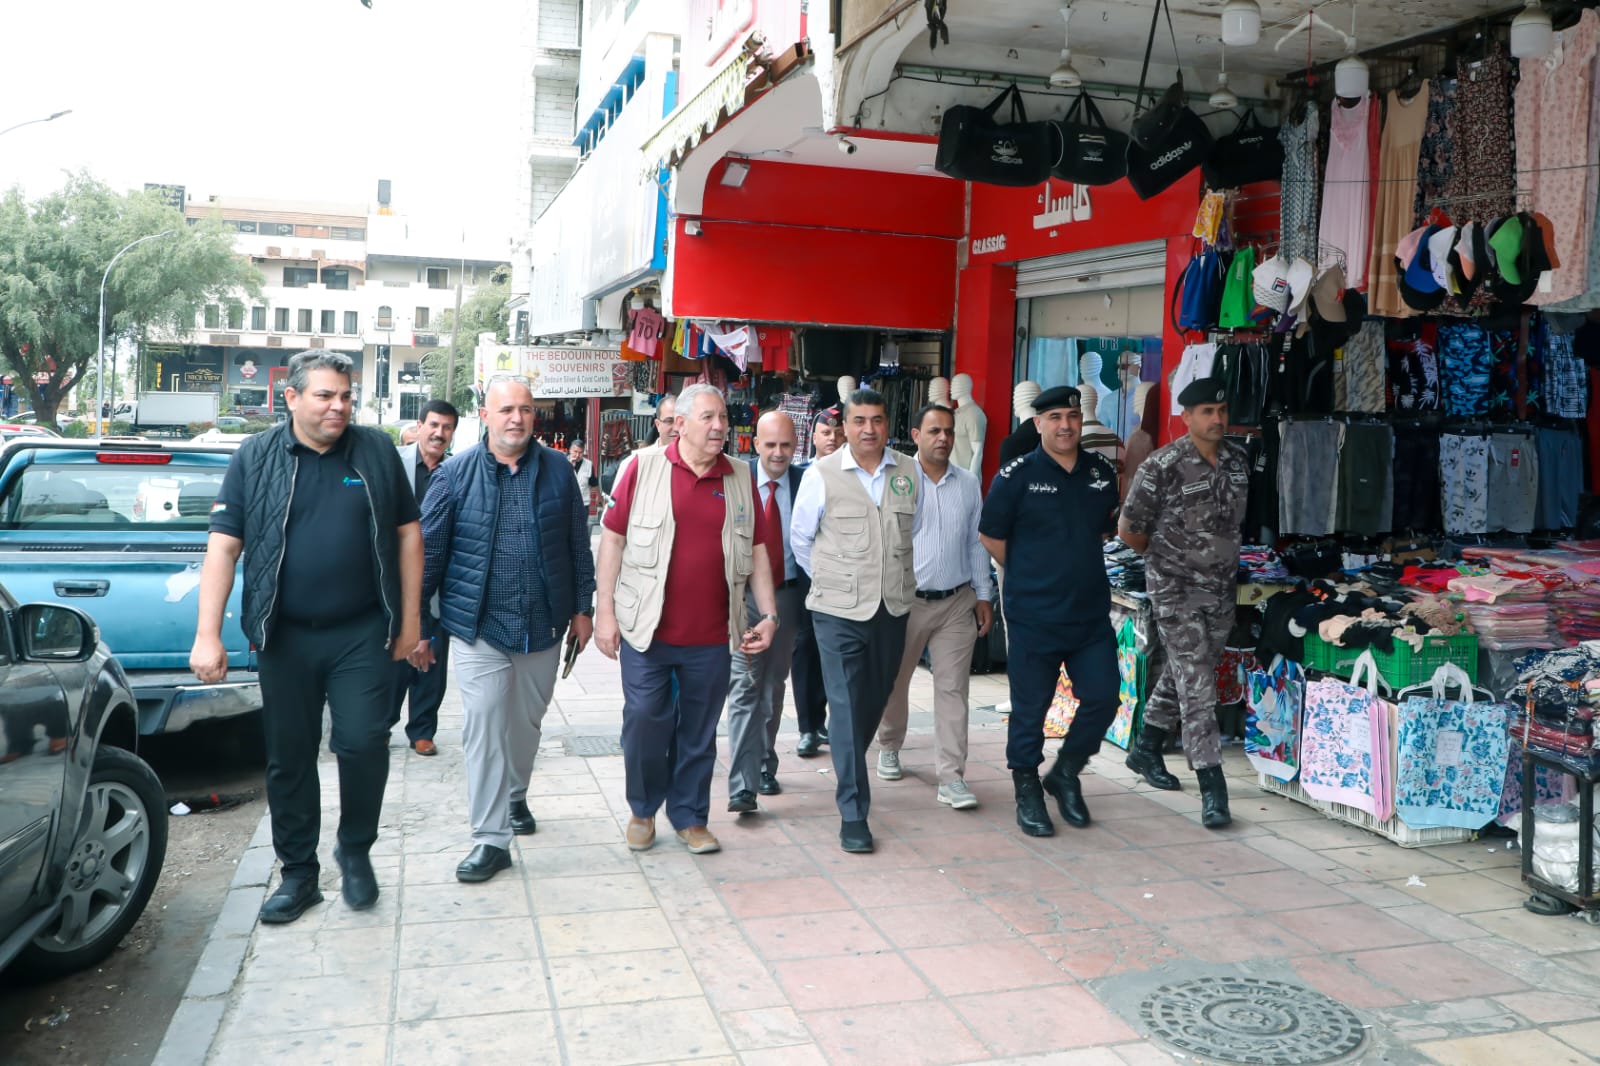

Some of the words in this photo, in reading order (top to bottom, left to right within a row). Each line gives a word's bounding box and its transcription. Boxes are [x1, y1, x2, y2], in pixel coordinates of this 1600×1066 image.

[1150, 146, 1184, 170] adidas
[972, 233, 1006, 255] CLASSIC
[638, 321, 653, 340] 10
[526, 351, 545, 361] THE
[548, 351, 592, 360] BEDOUIN
[594, 351, 621, 360] HOUS
[549, 363, 606, 373] SOUVENIRS
